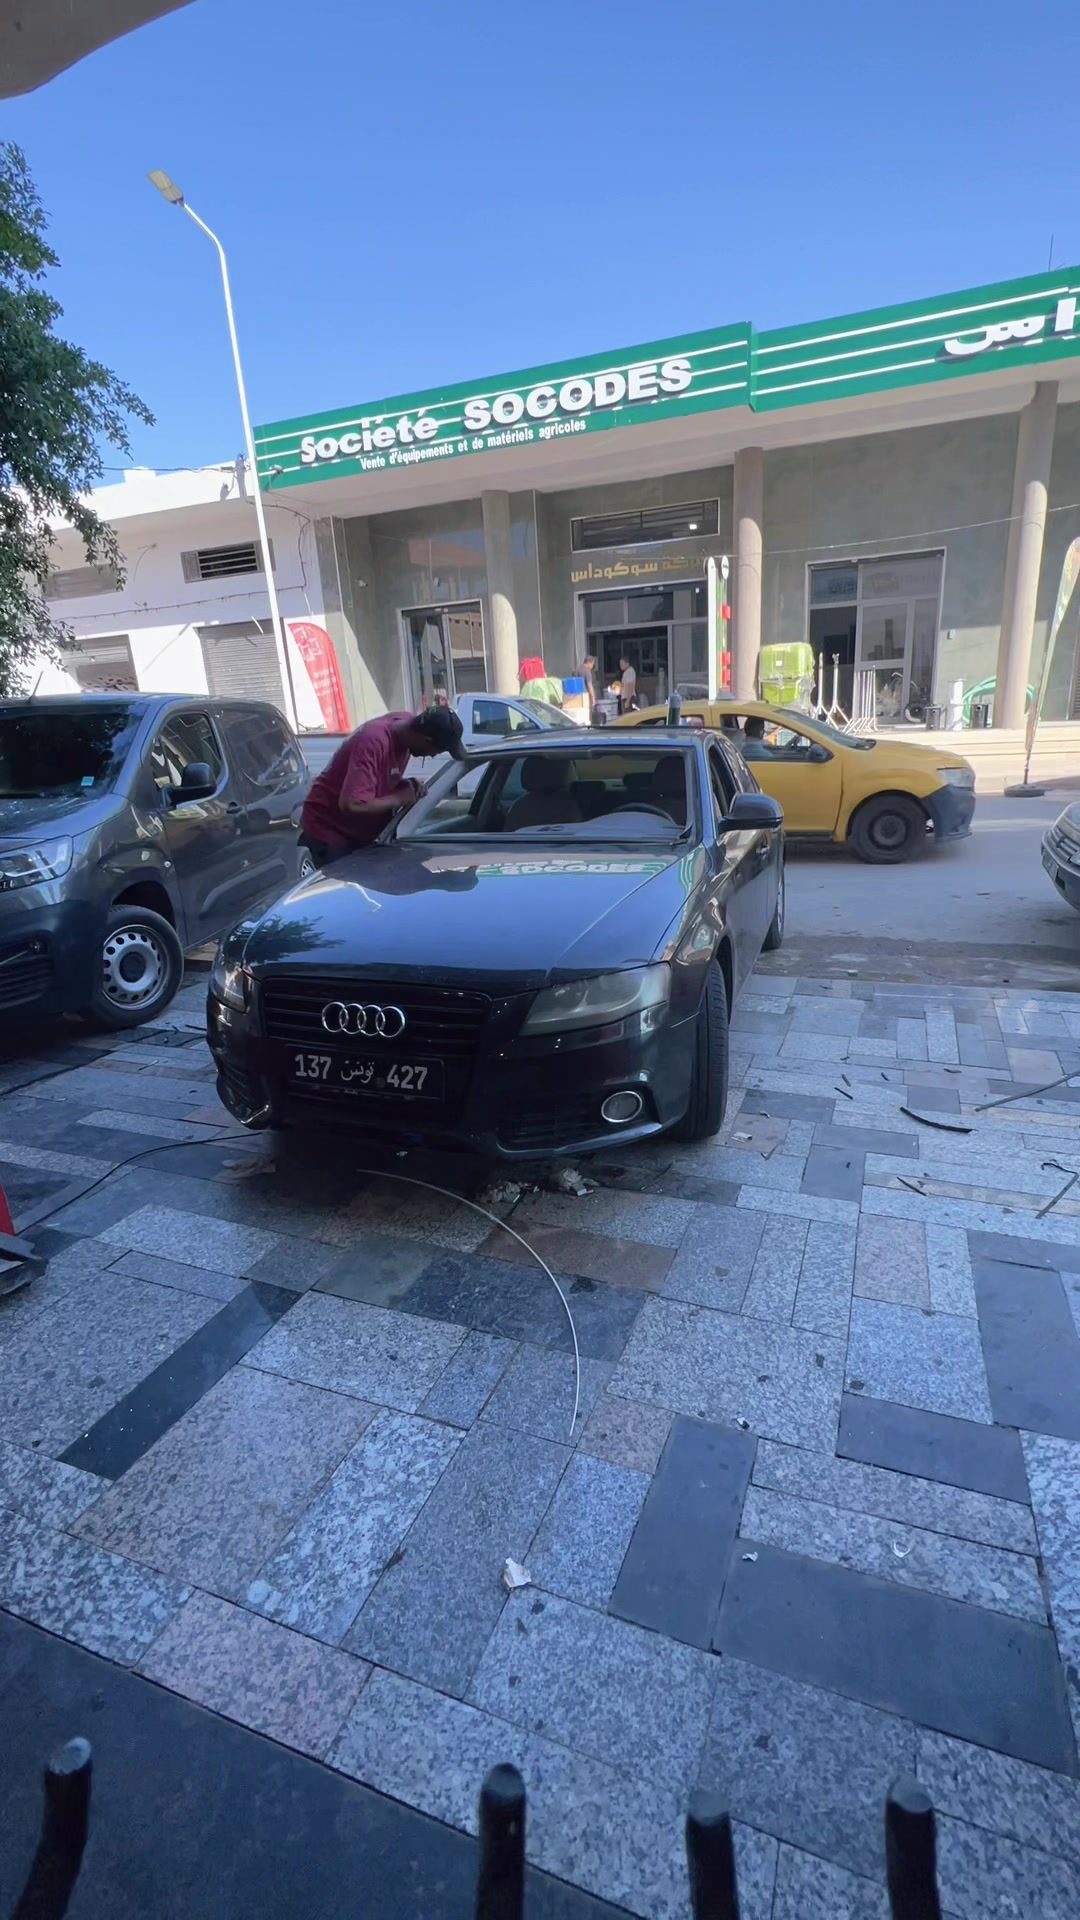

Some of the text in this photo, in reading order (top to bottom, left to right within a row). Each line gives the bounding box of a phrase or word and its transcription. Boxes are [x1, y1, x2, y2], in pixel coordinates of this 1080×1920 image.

[301, 358, 693, 463] Société SOCODES
[360, 419, 587, 470] Vente d'équipements et de matériels agricoles
[294, 1053, 429, 1091] 137 تونس 427
